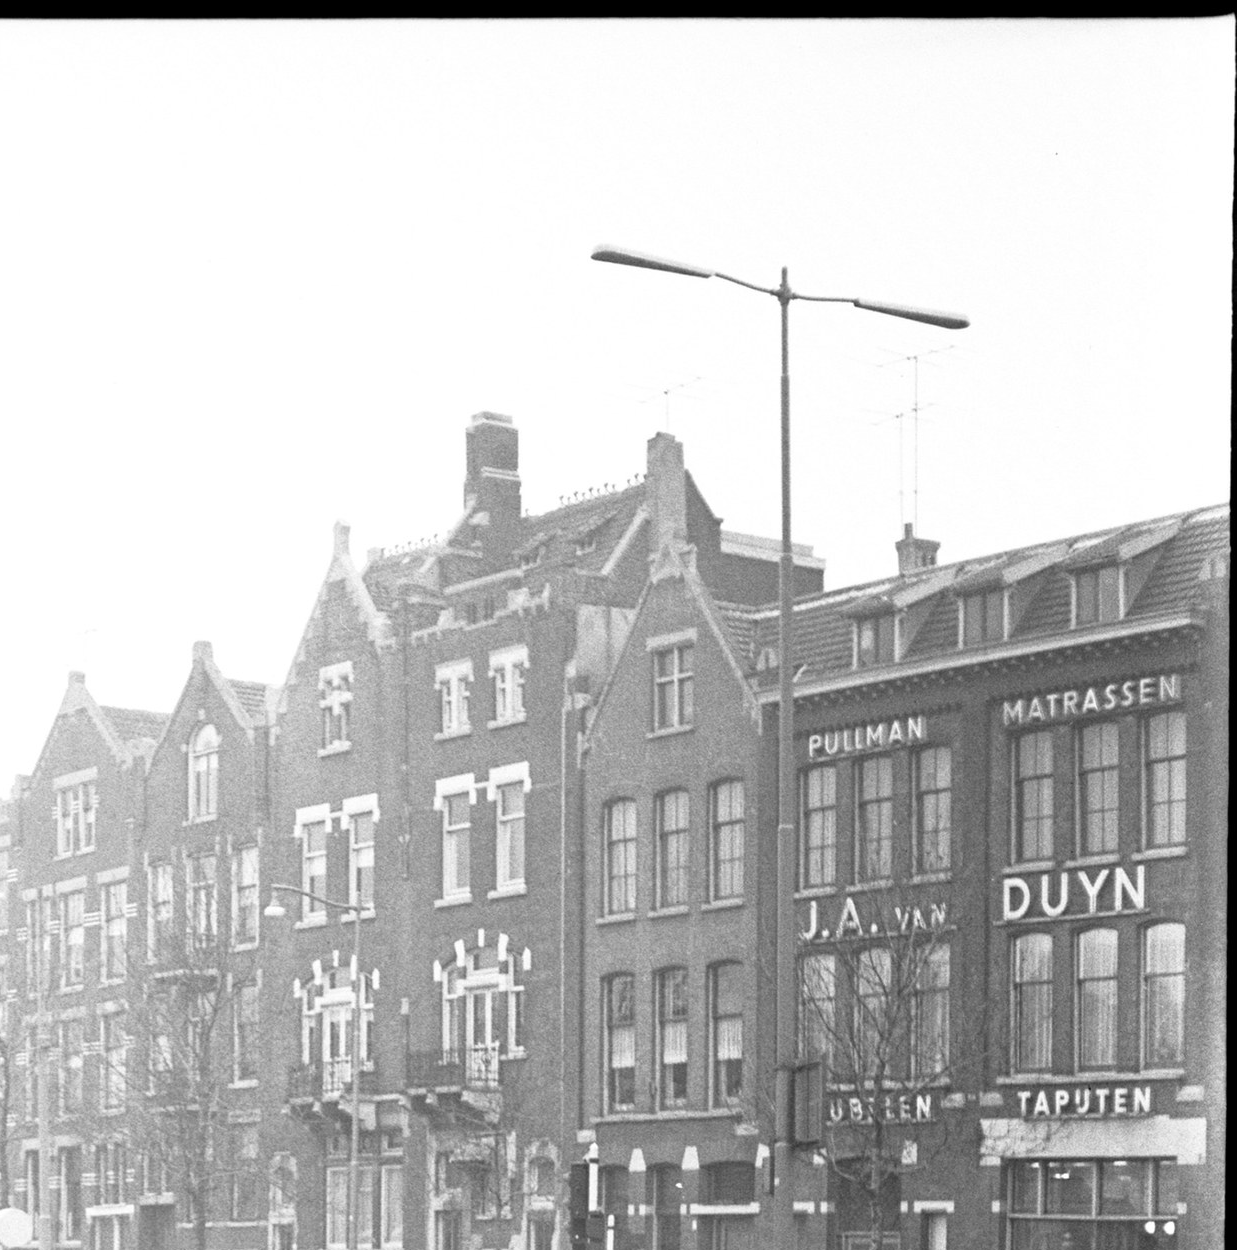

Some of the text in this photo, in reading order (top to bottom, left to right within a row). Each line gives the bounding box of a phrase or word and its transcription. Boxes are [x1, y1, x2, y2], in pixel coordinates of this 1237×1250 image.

[1003, 674, 1179, 725] MATRASSEN
[808, 717, 924, 757] PULLMAN
[1003, 866, 1145, 922] DUYN
[1018, 1086, 1151, 1117] TAPUTEN
